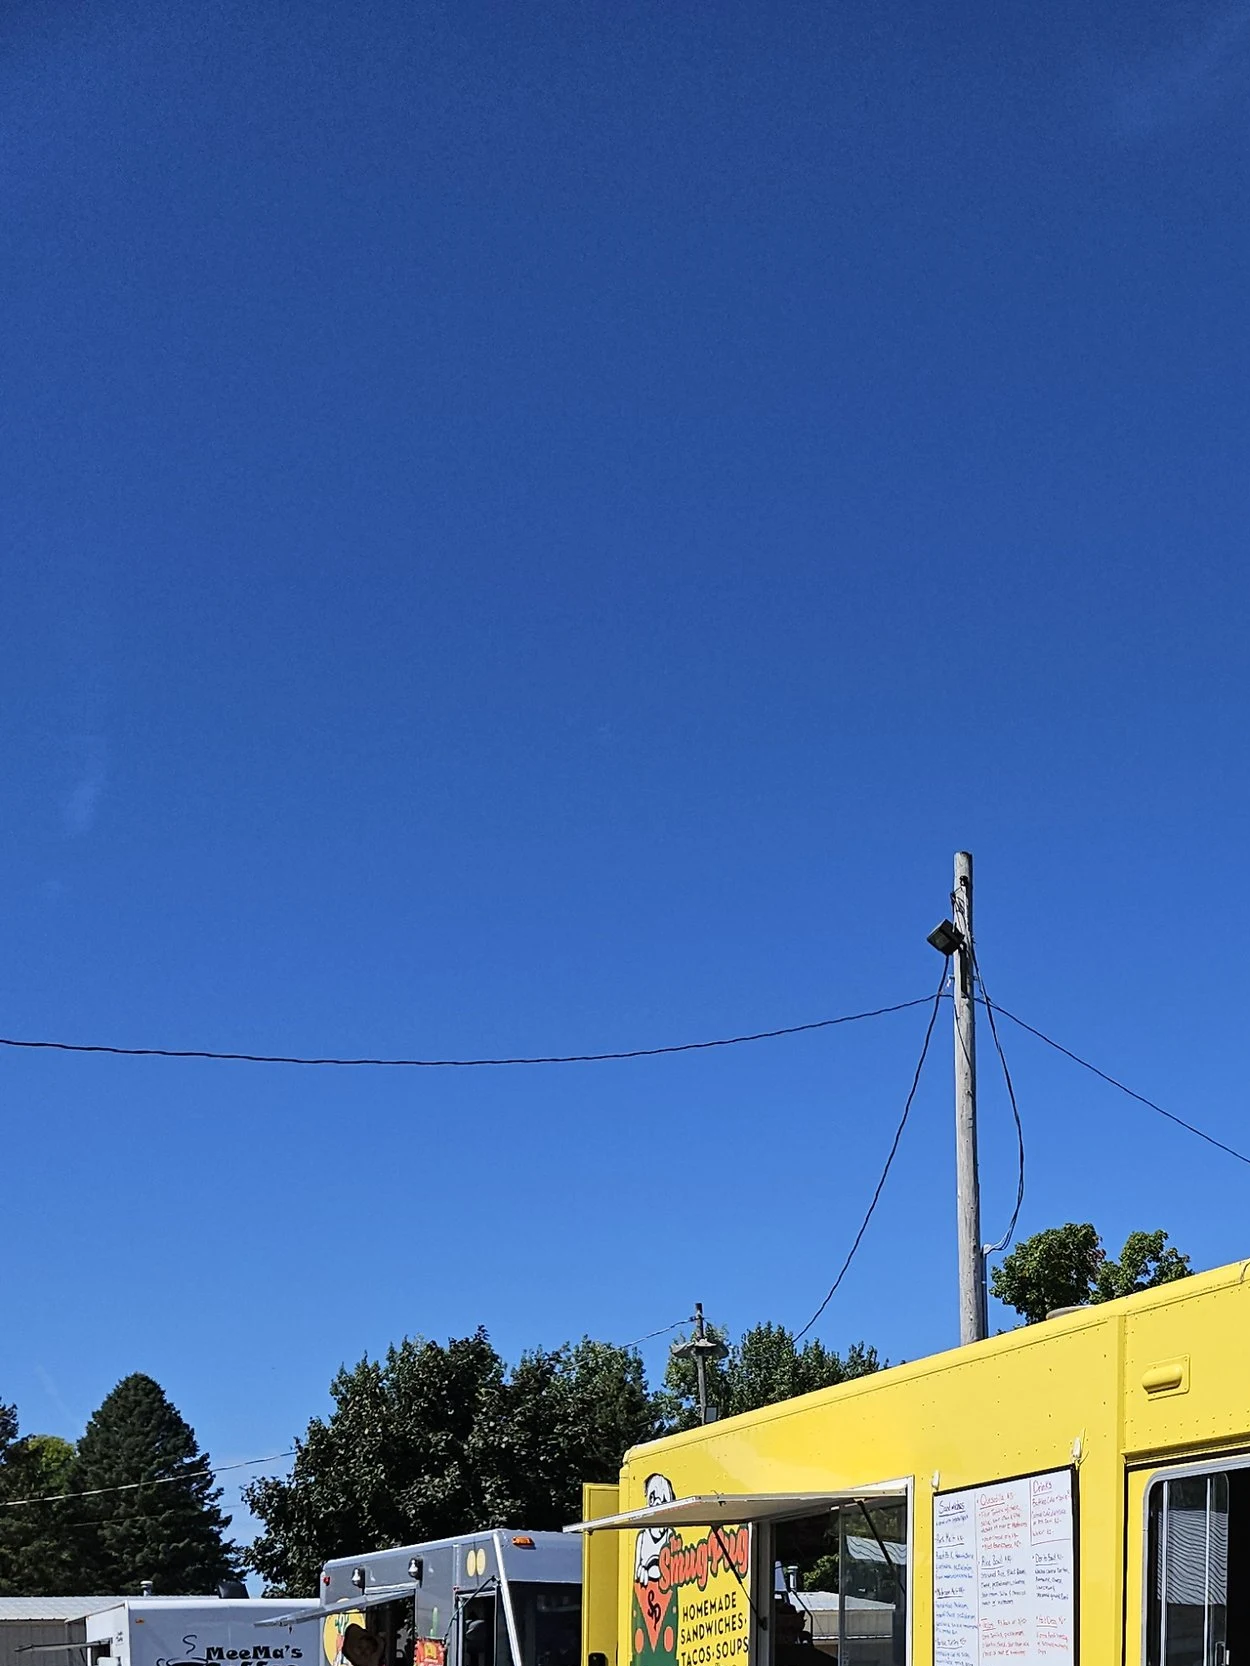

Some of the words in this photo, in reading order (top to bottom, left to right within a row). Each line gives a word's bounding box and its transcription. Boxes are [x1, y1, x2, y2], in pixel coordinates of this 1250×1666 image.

[658, 1542, 708, 1592] Smug
[708, 1527, 749, 1578] Pug
[682, 1590, 737, 1623] HOMEMADE
[206, 1645, 303, 1660] MeeMa's
[715, 1635, 749, 1661] SOUPS
